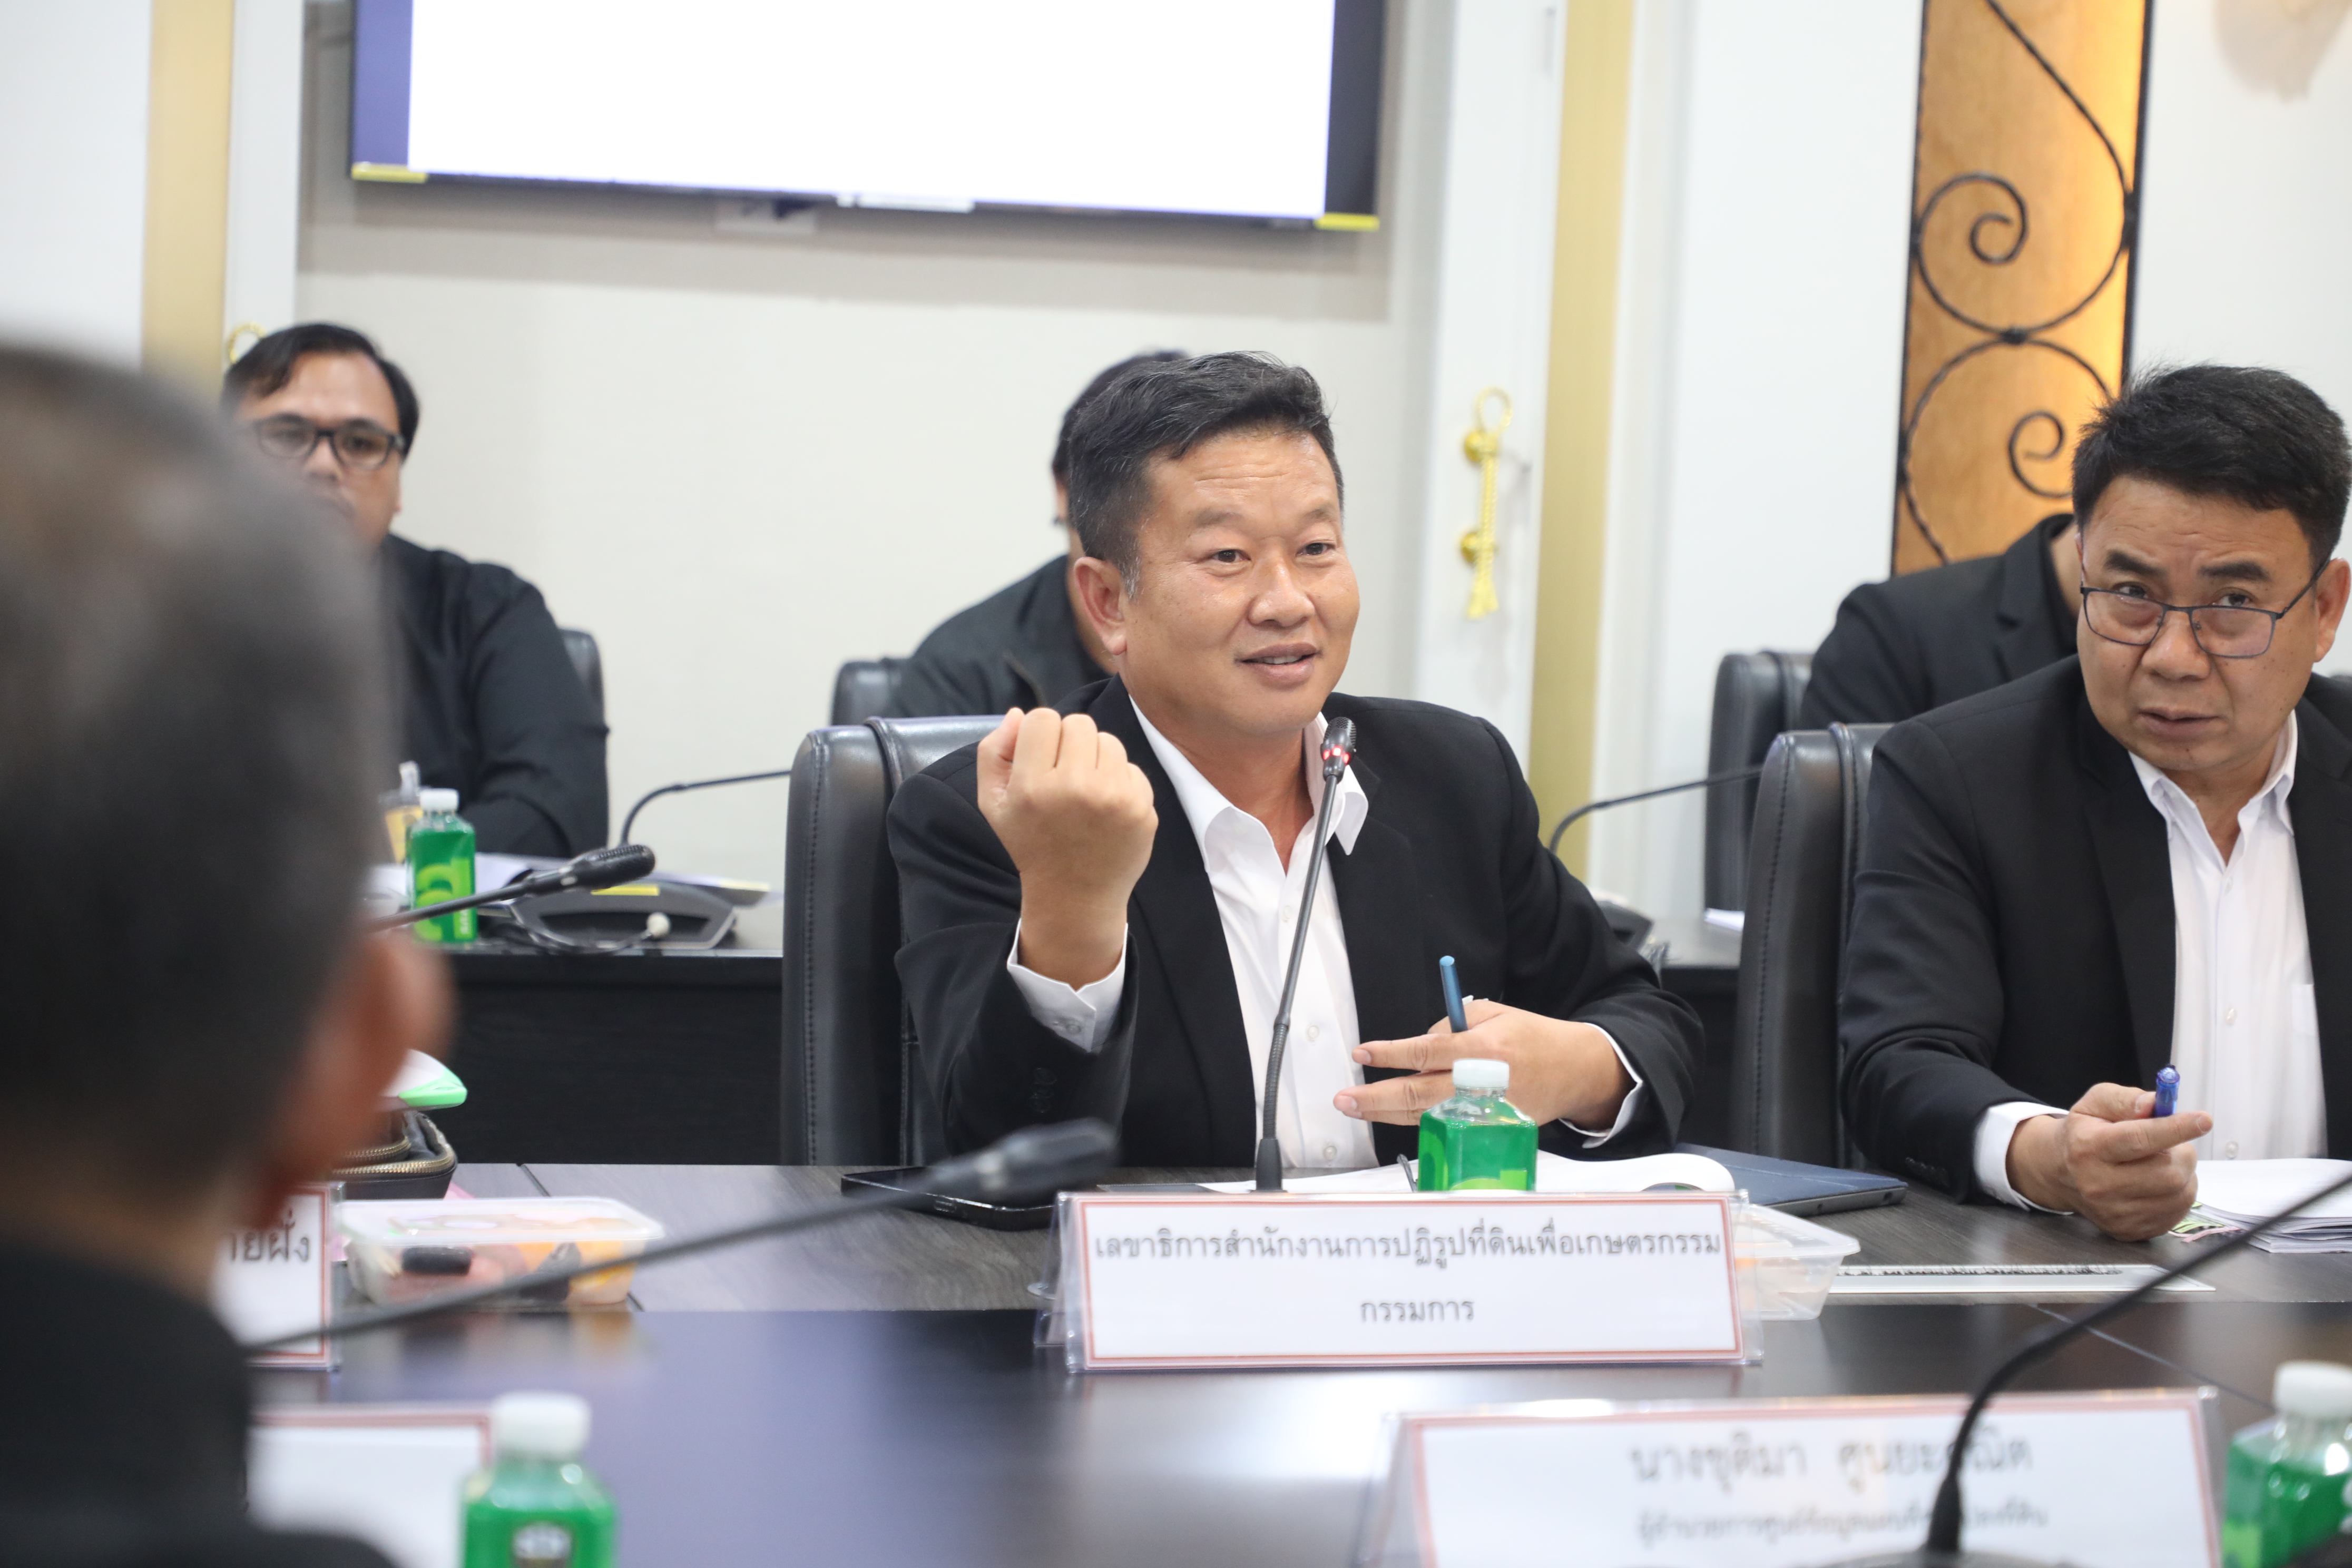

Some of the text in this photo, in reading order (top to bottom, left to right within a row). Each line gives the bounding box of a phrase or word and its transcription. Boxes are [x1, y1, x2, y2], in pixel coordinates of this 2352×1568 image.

[1096, 1217, 1721, 1269] เลขาธิการสำนักงานการปฏิรูปที่ดินเพื่อเกษตรกรรม
[1360, 1300, 1475, 1322] กรรมการ
